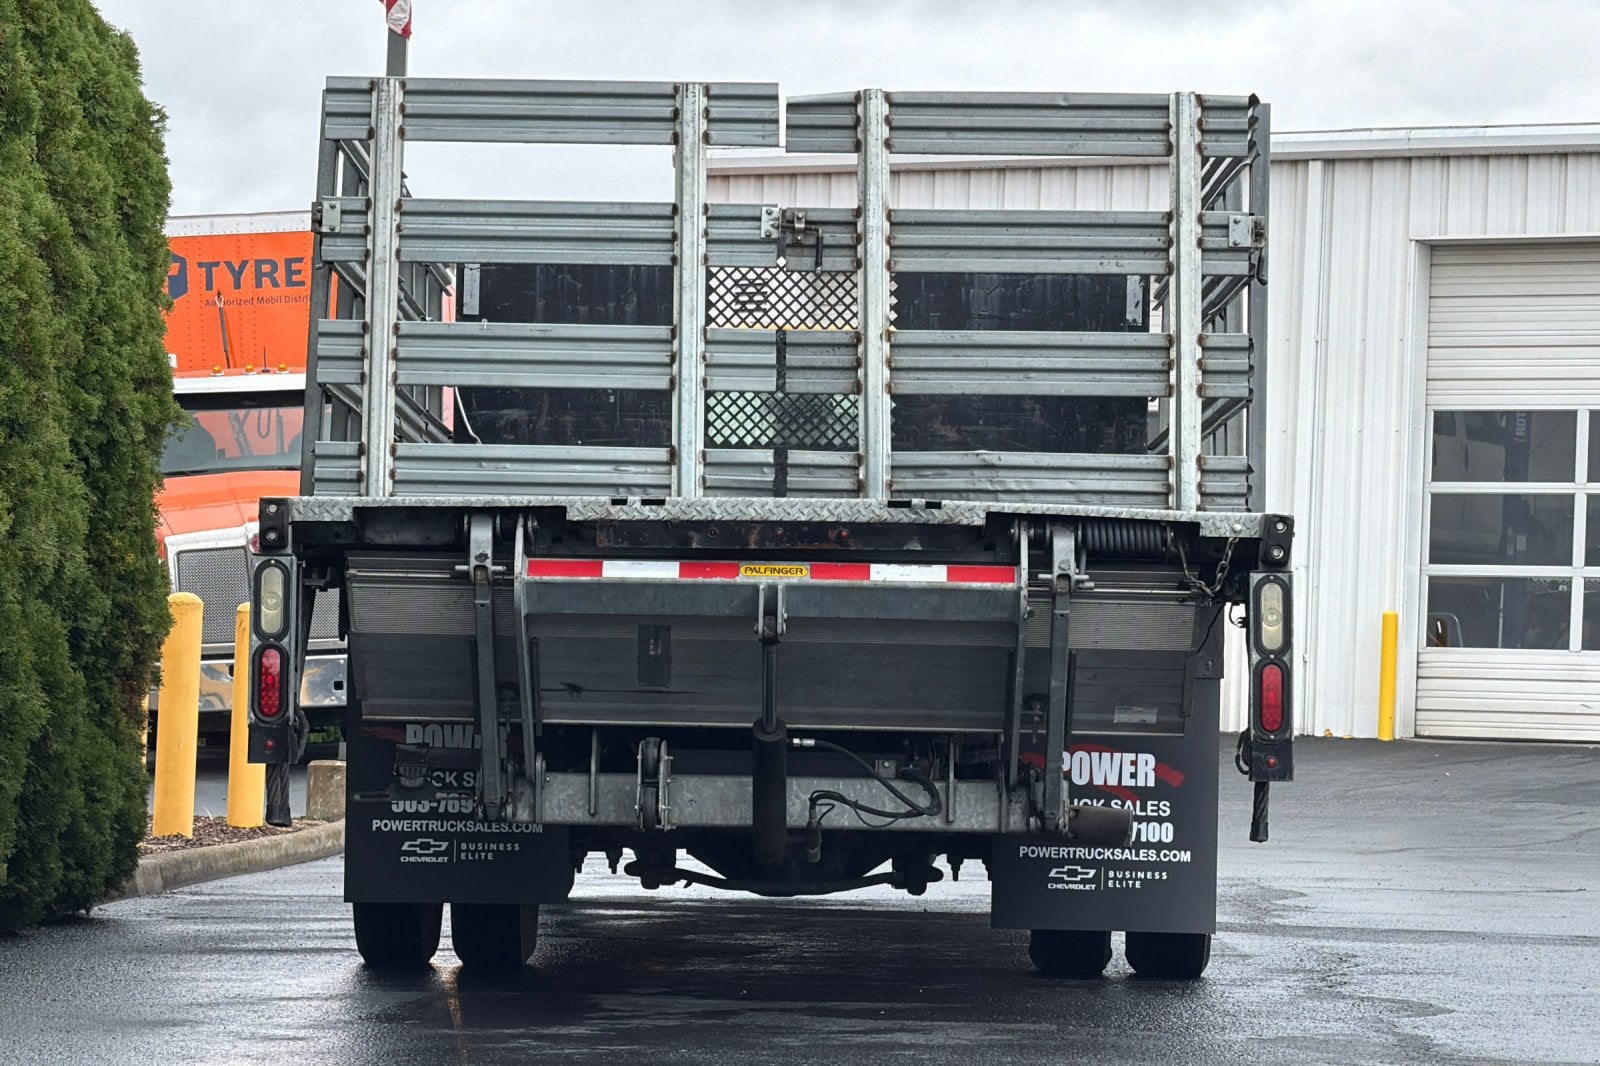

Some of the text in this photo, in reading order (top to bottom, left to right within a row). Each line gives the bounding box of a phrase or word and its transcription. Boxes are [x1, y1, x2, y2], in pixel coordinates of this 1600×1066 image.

[205, 296, 254, 307] Auorized
[256, 294, 283, 305] Mobil
[745, 566, 803, 575] PALFINGER
[372, 819, 543, 833] POWERTRUCKSALES.COM
[460, 842, 520, 851] BUSINESS
[460, 852, 494, 860] ELITE
[1019, 846, 1191, 862] POWERTRUCKSALES.COM
[1108, 870, 1167, 880] BUSINESS
[1108, 880, 1141, 889] ELITE
